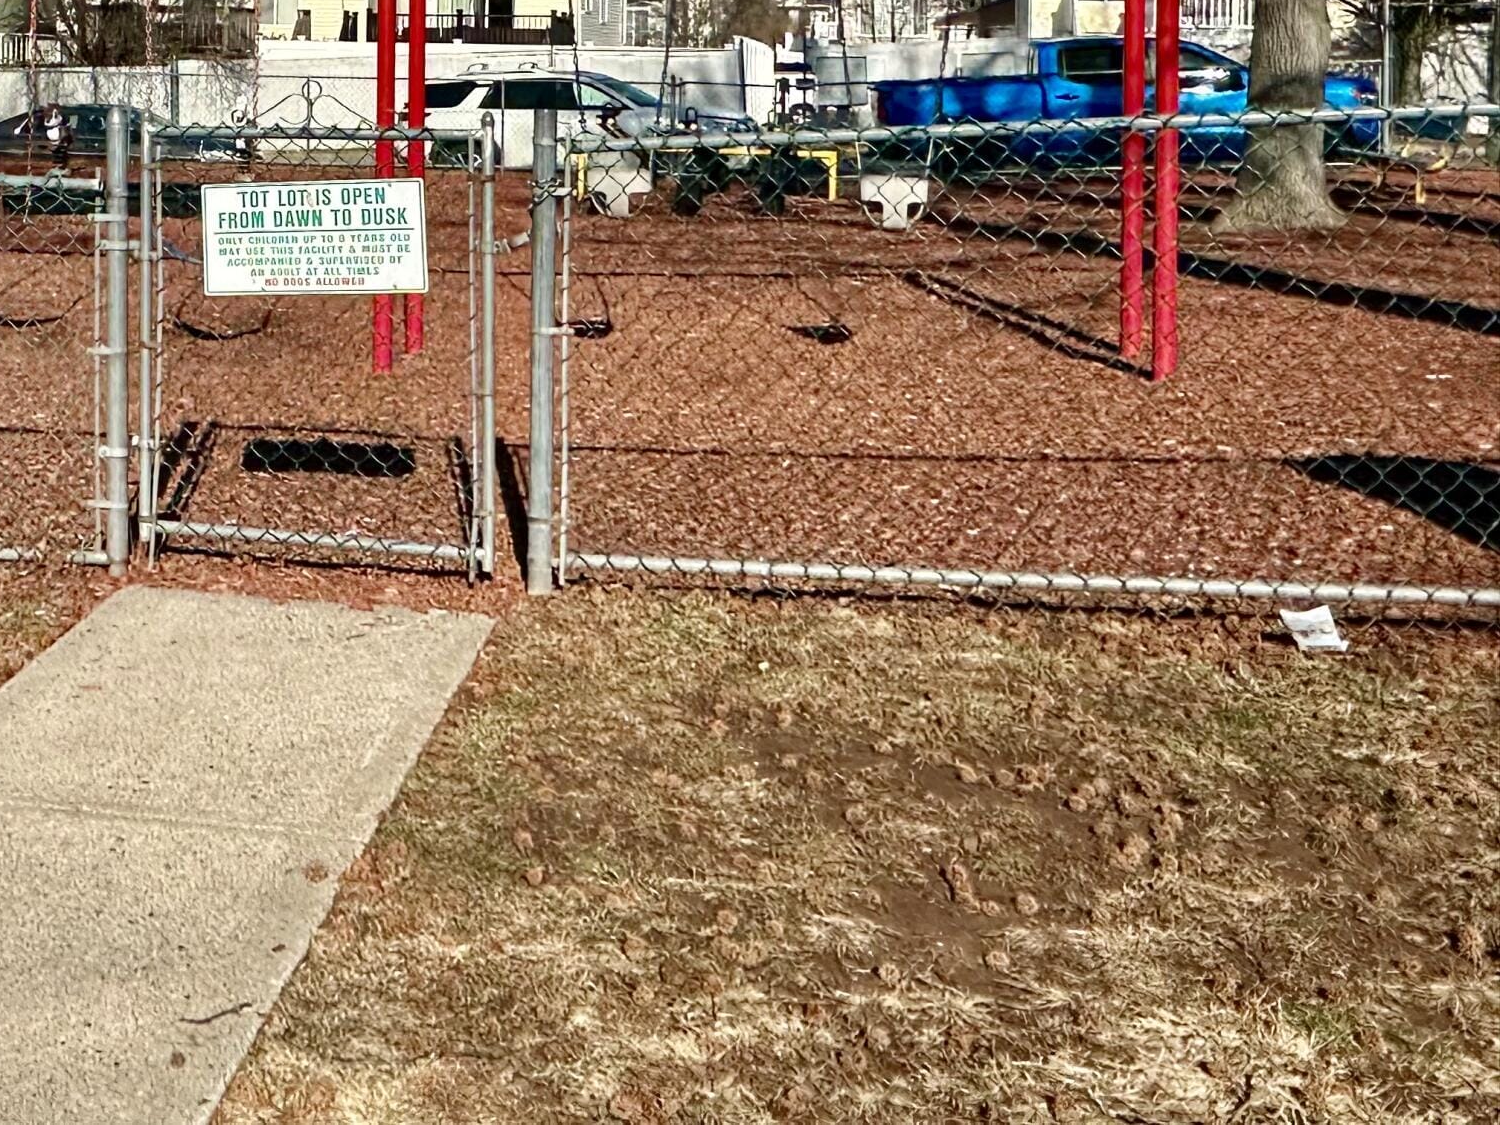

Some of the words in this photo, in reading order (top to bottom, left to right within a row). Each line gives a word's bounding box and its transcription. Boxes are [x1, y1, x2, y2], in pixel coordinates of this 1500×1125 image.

[236, 190, 270, 208] TOT
[278, 189, 307, 206] LOT
[315, 188, 331, 206] IS
[341, 187, 385, 205] OPEN
[218, 210, 265, 229] FROM
[273, 209, 323, 227] DAWN
[330, 208, 352, 226] TO
[361, 207, 408, 225] DUSK
[218, 237, 243, 245] ONLY
[248, 235, 298, 244] CHILDREN
[303, 235, 316, 244] UP
[321, 235, 334, 243] TO
[350, 234, 385, 242] YEARS
[390, 233, 411, 242] OLD
[219, 247, 241, 255] MAY
[245, 246, 265, 255] USE
[270, 246, 294, 255] THIS
[299, 245, 343, 254] FACILITY
[348, 245, 356, 253] &
[361, 244, 392, 253] MUST
[397, 244, 411, 253] BE
[227, 257, 301, 267] ACCOMPANIED
[306, 257, 313, 265] &
[319, 255, 384, 265] SUPERVISED
[389, 255, 403, 264] BY
[250, 268, 265, 277] AN
[270, 267, 301, 276] ADULT
[306, 267, 318, 276] AT
[323, 266, 341, 275] ALL
[346, 266, 380, 275] TIMES
[265, 277, 279, 286] NO
[283, 277, 310, 286] DOGS
[315, 276, 365, 285] ALLOWED
